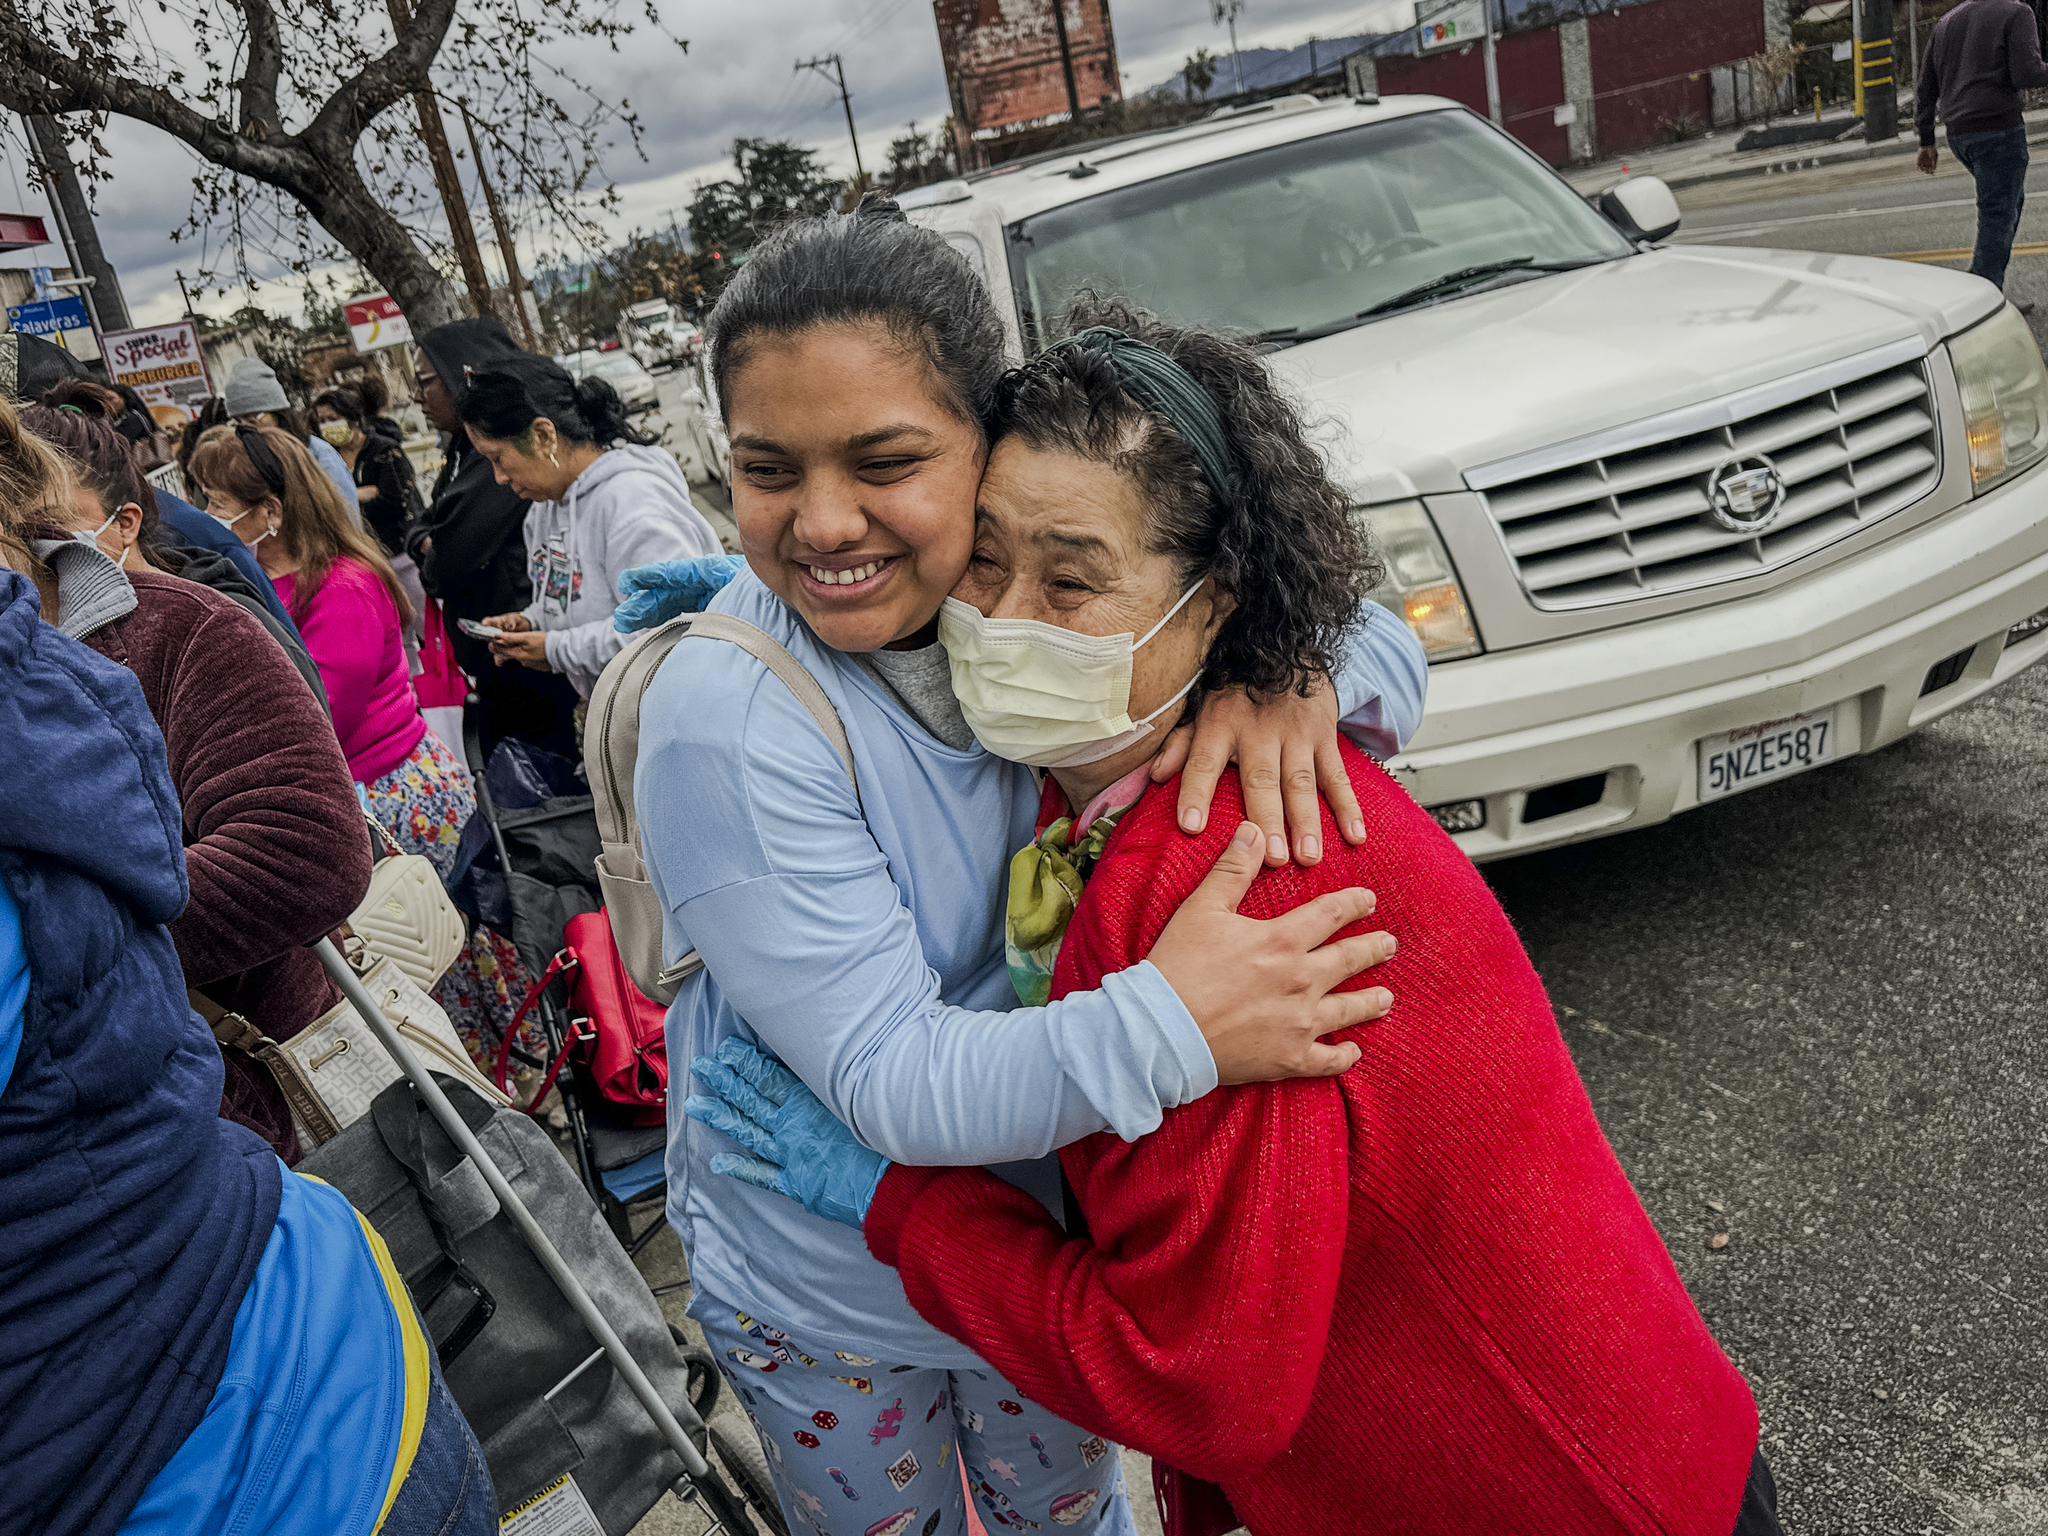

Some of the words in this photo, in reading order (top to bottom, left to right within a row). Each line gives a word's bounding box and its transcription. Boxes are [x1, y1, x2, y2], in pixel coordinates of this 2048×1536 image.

[12, 314, 81, 335] Calaveras
[114, 328, 191, 368] Special
[125, 332, 159, 350] SUPER
[117, 360, 202, 387] HAMBURGER
[1708, 720, 1829, 790] 5NZE587
